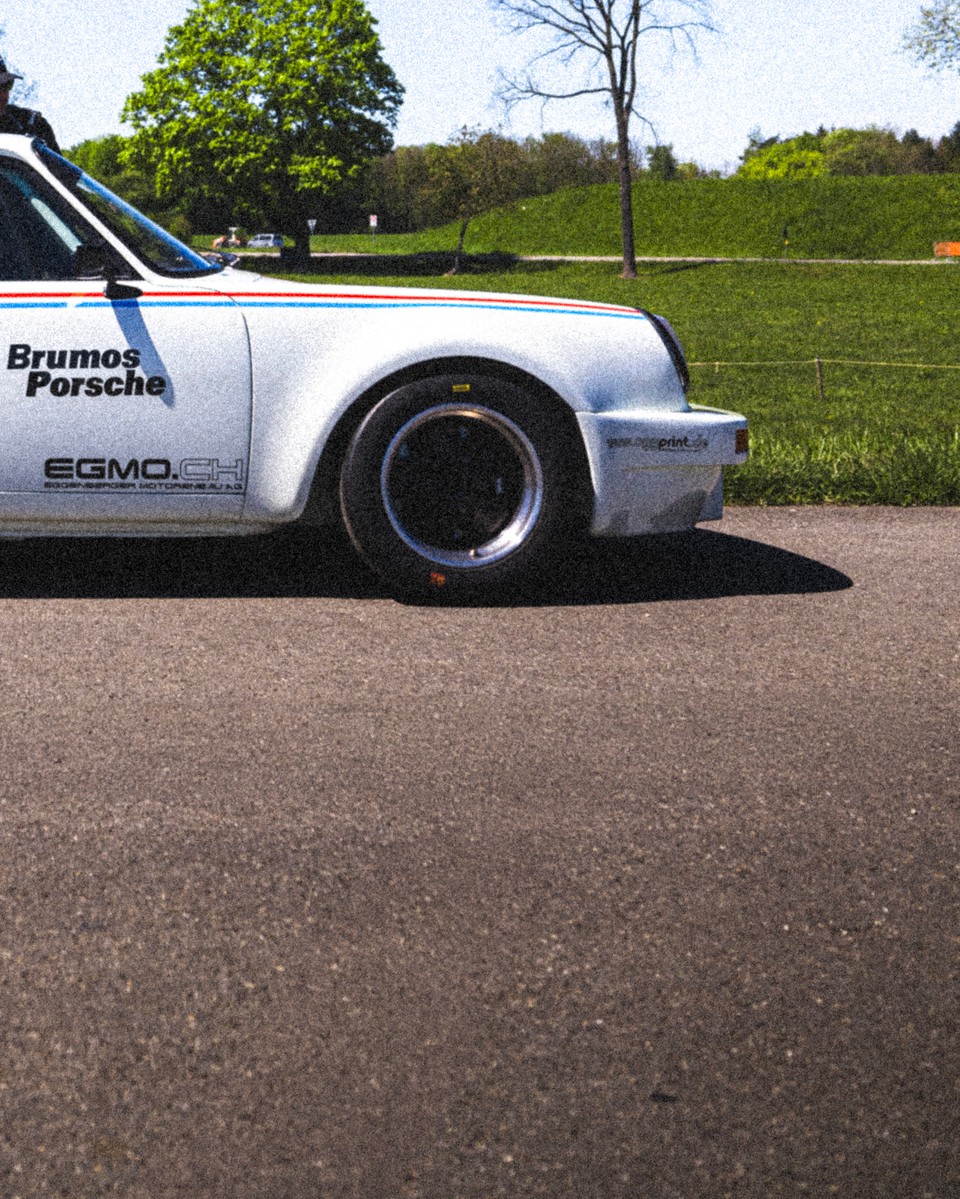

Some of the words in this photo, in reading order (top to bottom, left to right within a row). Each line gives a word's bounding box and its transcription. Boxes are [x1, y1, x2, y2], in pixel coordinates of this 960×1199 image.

[7, 343, 141, 369] Brumos
[25, 370, 166, 397] Porsche
[44, 458, 243, 481] EGMO.CH
